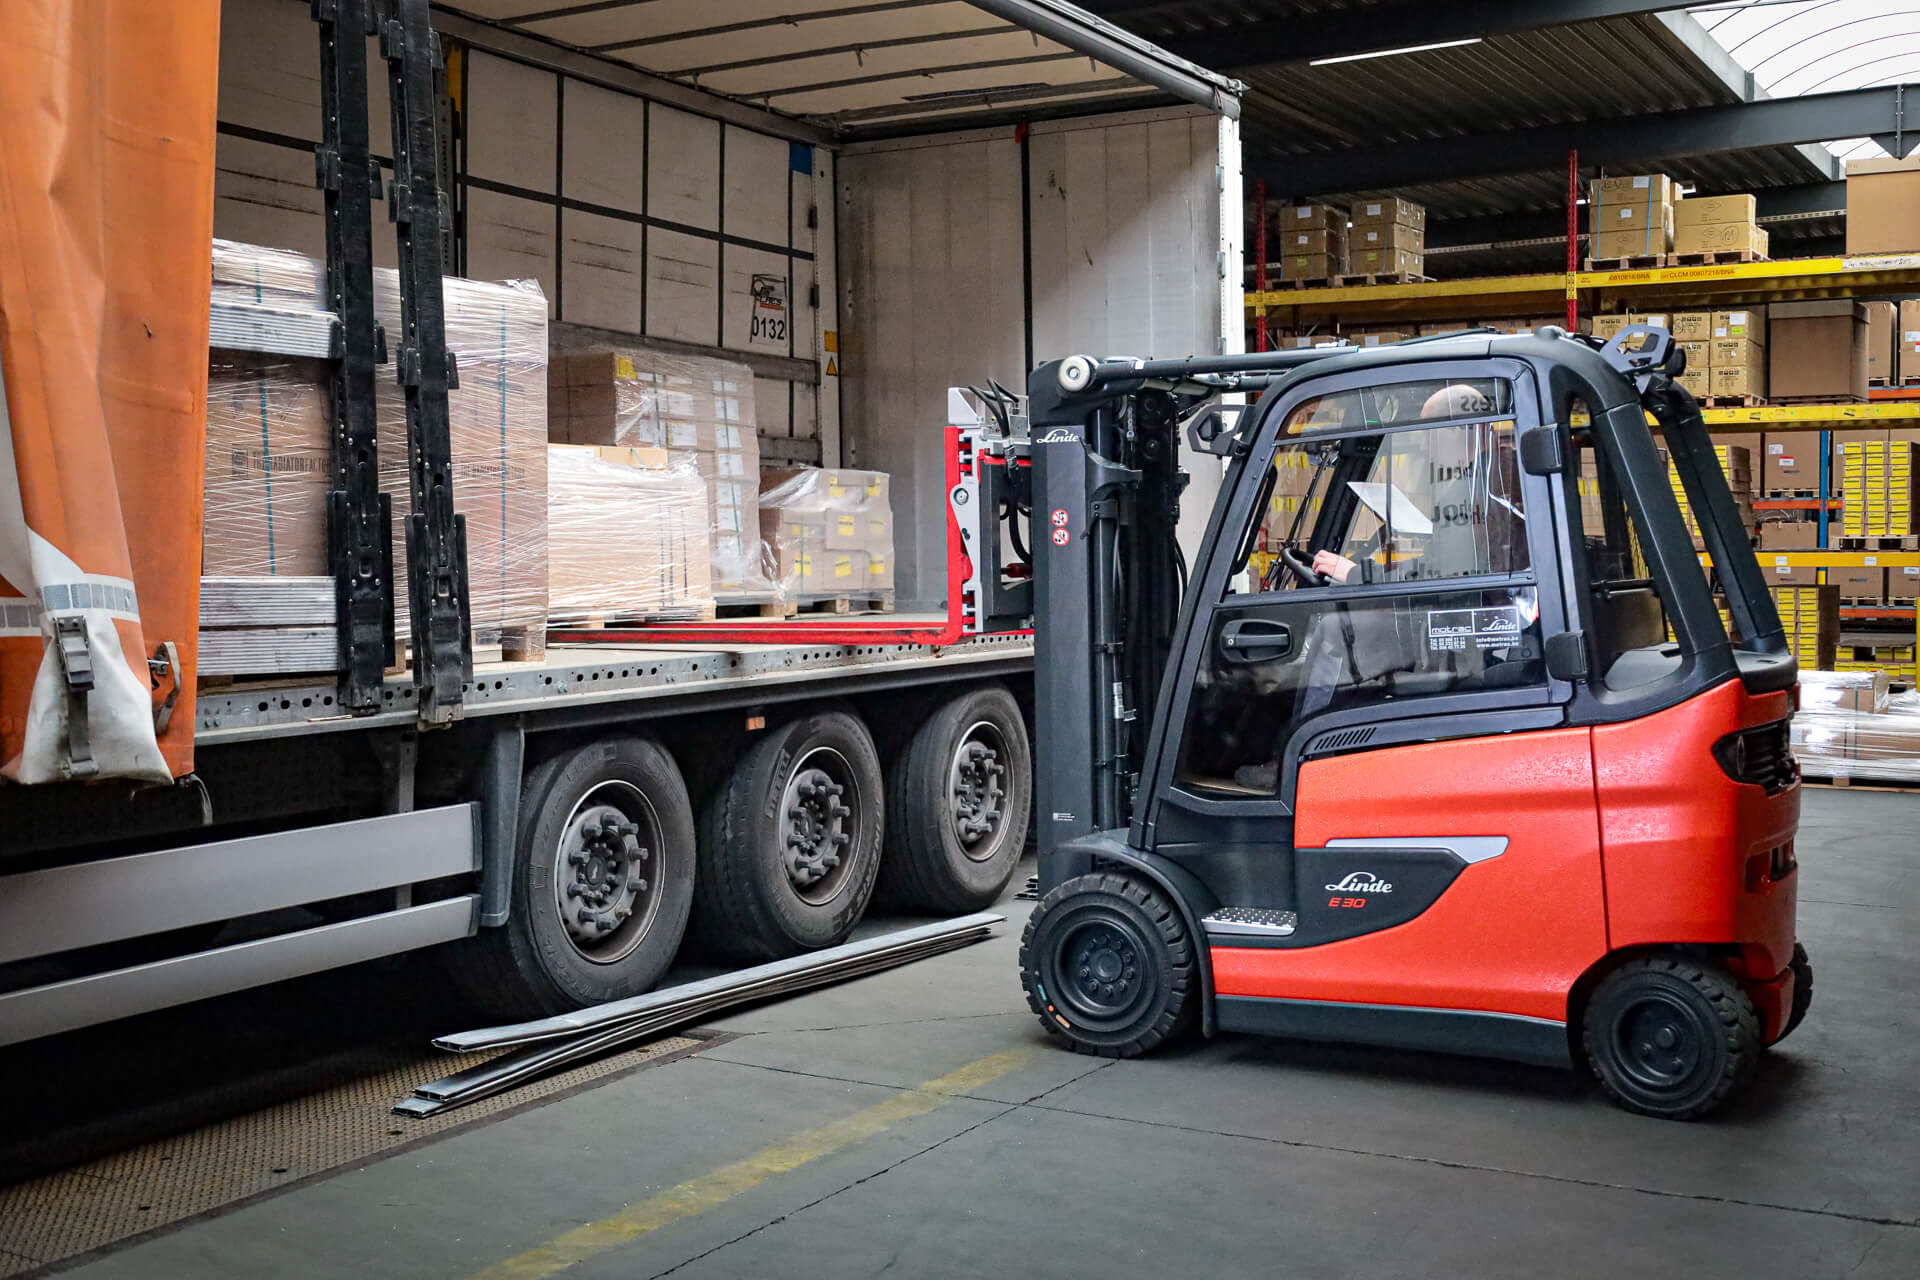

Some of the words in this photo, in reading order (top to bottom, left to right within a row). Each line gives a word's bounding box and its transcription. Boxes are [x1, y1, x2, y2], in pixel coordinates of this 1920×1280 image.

[752, 315, 785, 340] 0132
[1036, 428, 1080, 444] Linde
[1431, 626, 1472, 635] motrac
[1482, 618, 1517, 632] Linde
[1324, 871, 1393, 893] Linde
